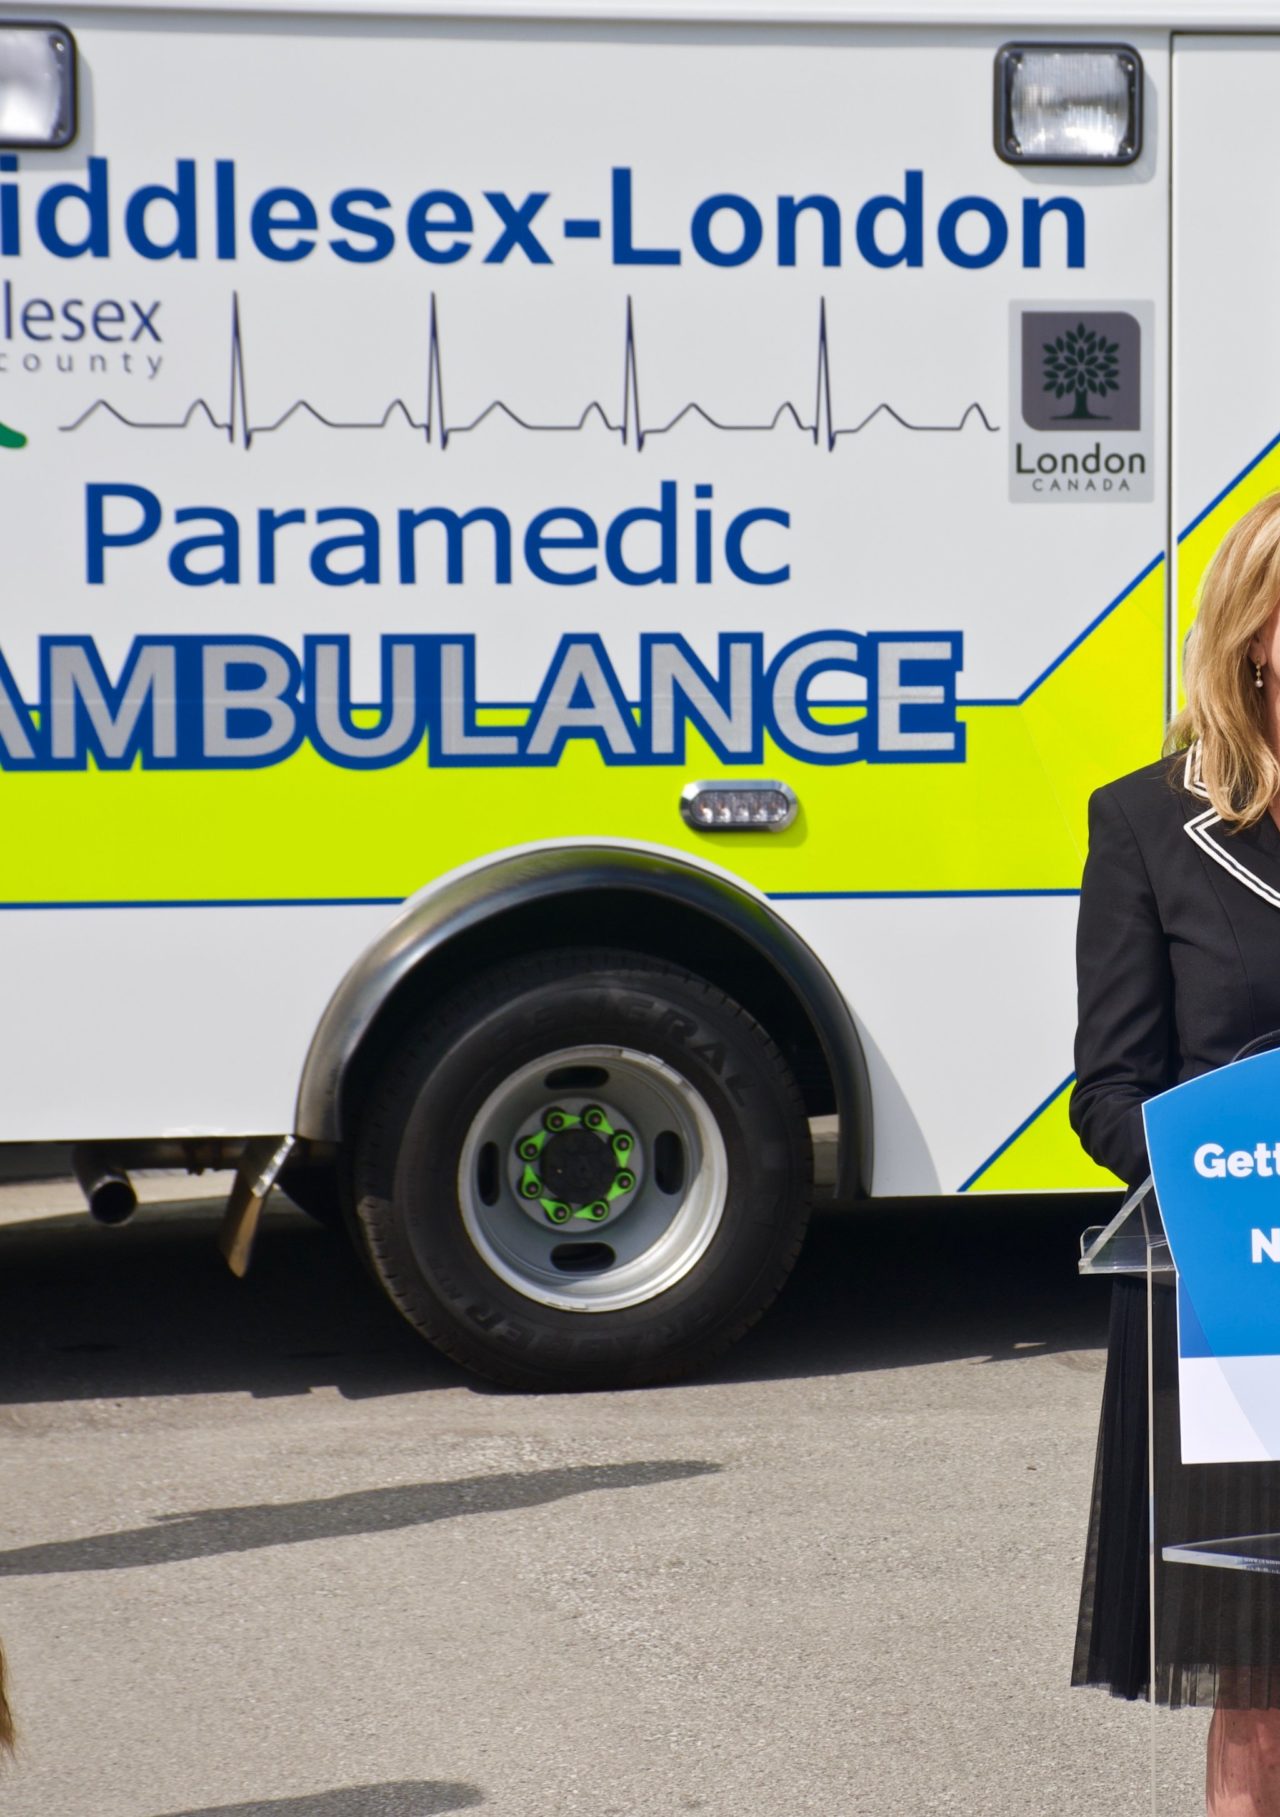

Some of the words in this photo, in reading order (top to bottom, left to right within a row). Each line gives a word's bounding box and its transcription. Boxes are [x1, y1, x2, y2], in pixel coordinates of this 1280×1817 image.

[1016, 442, 1146, 475] London
[1031, 478, 1130, 492] CANADA
[86, 480, 791, 587] Paramedic
